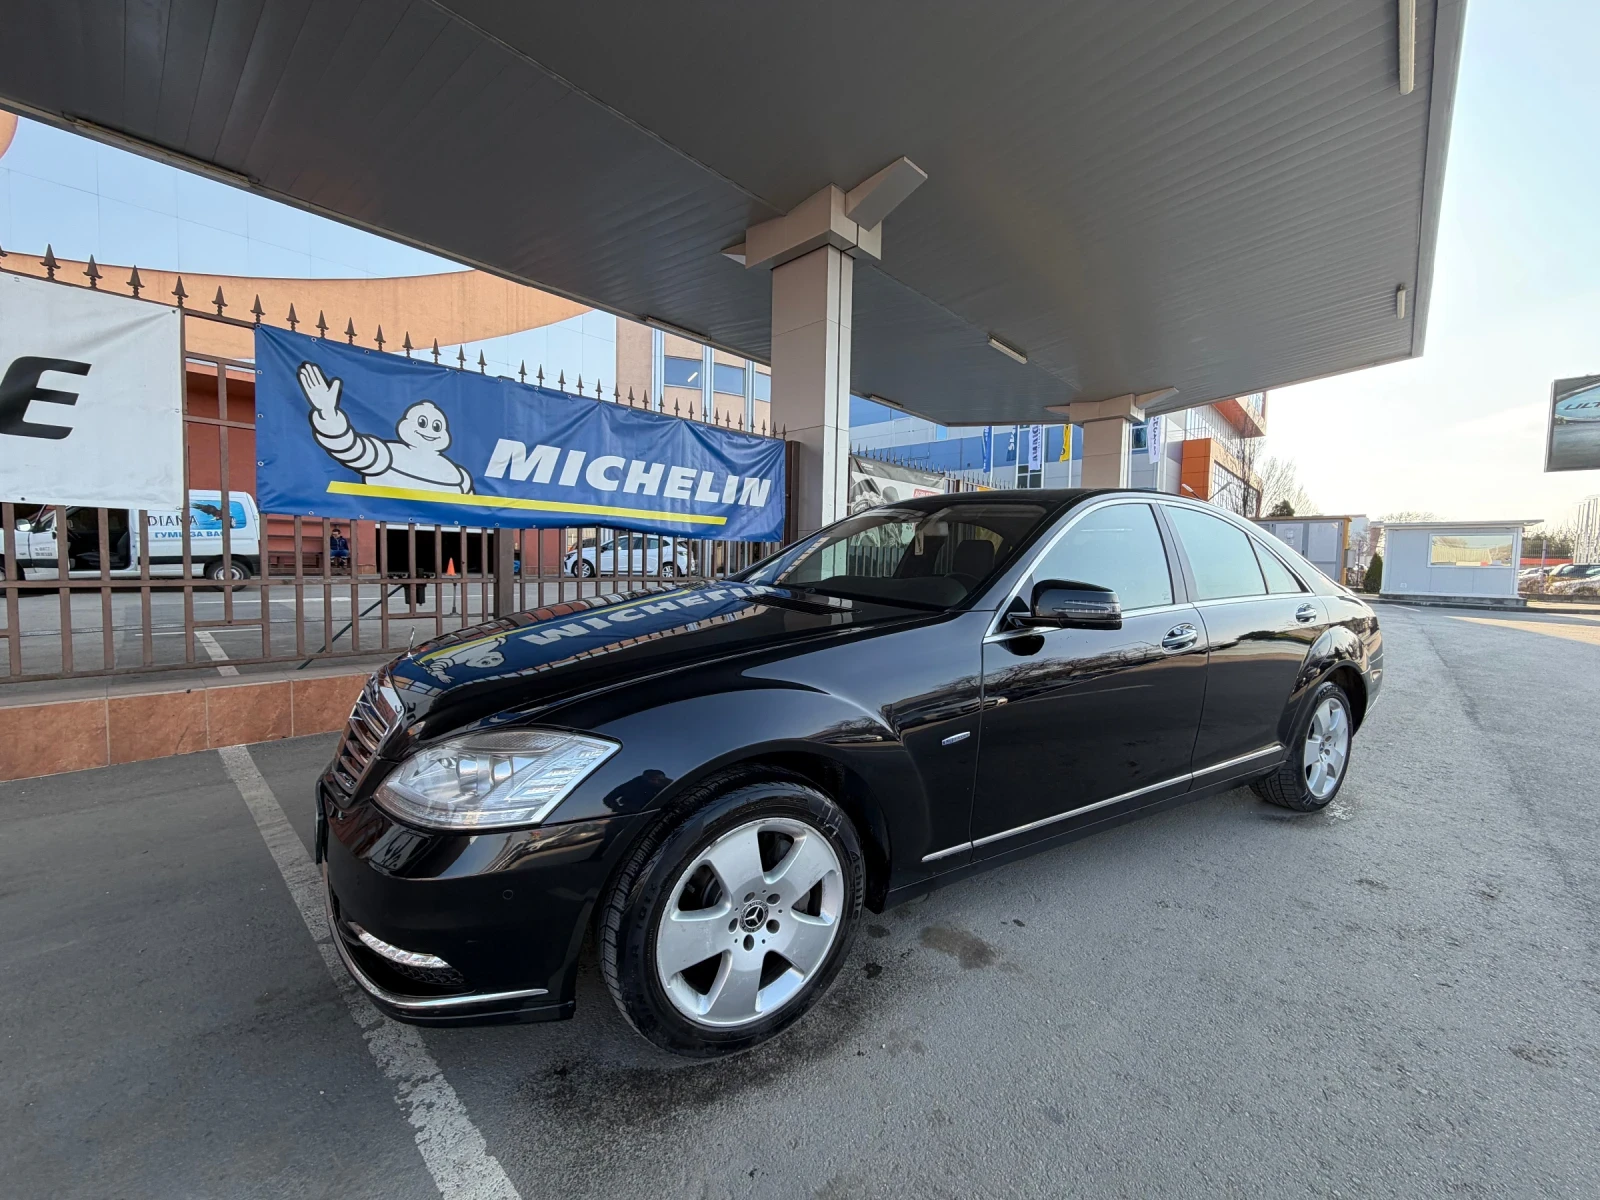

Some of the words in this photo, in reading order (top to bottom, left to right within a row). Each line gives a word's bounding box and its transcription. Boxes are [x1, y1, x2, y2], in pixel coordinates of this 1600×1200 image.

[0, 355, 92, 440] E
[483, 437, 772, 508] MICHELIN
[206, 530, 224, 538] ВА
